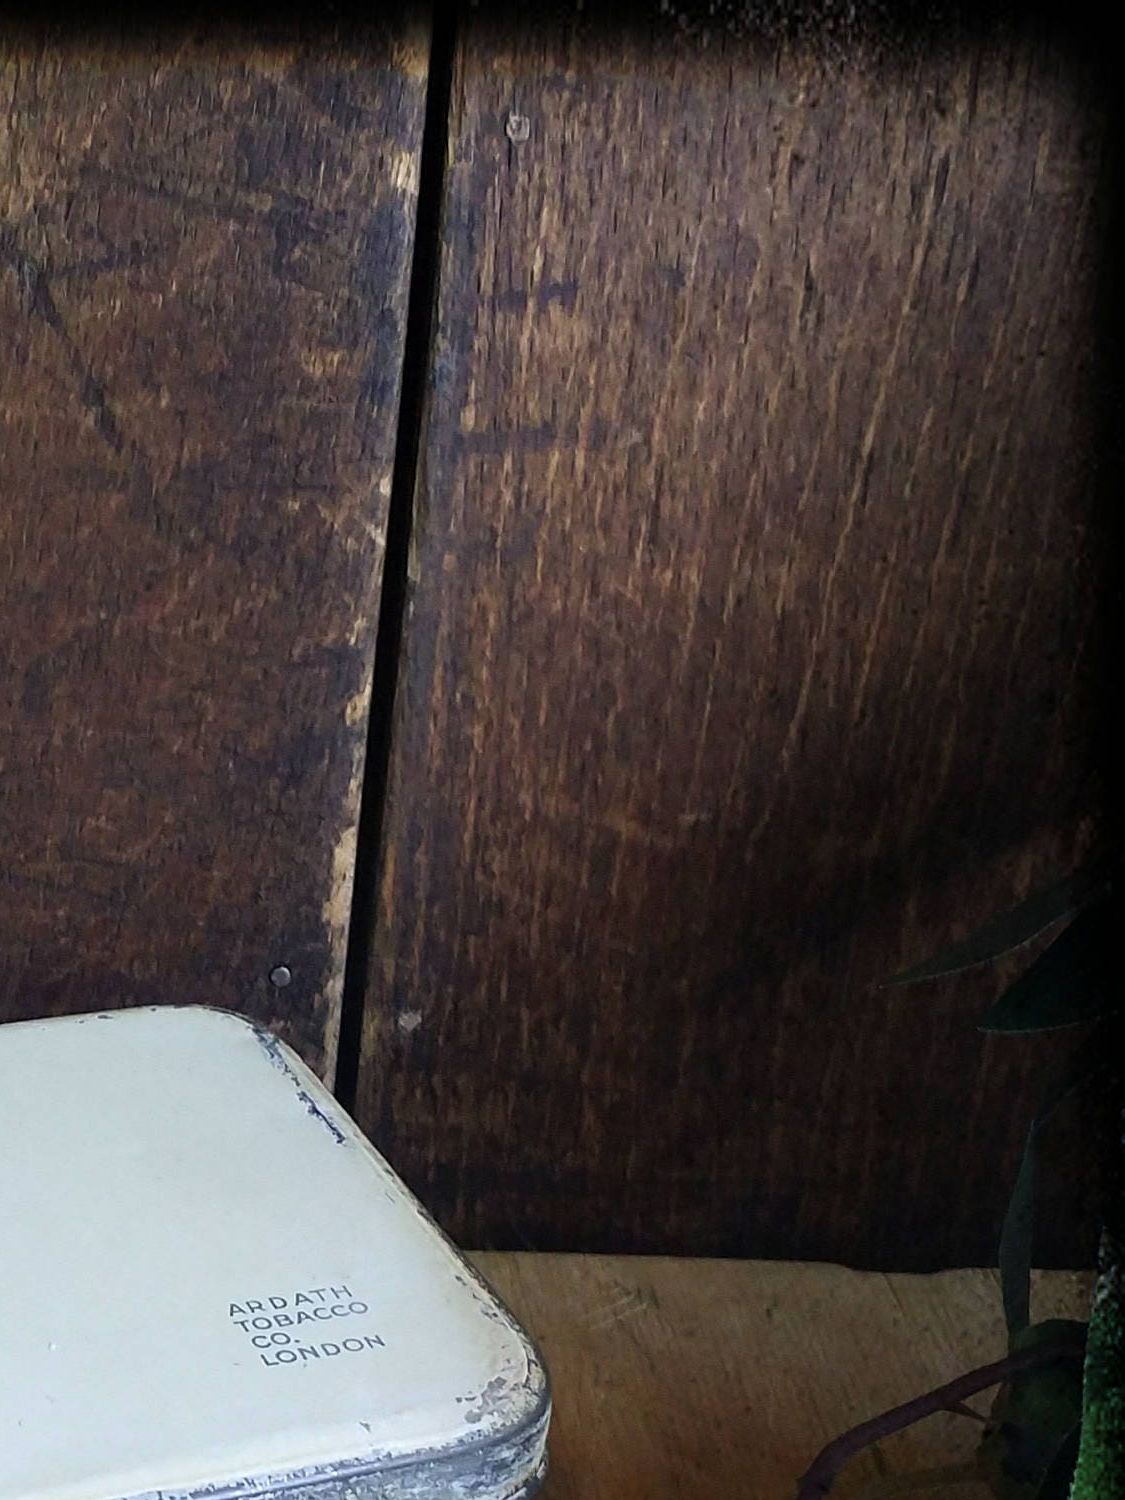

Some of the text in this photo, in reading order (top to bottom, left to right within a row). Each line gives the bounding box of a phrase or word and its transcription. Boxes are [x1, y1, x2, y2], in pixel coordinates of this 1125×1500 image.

[229, 1285, 353, 1317] ARDATH
[233, 1301, 369, 1332] TOBACCO
[251, 1332, 300, 1349] CO.
[260, 1334, 386, 1366] LONDON
